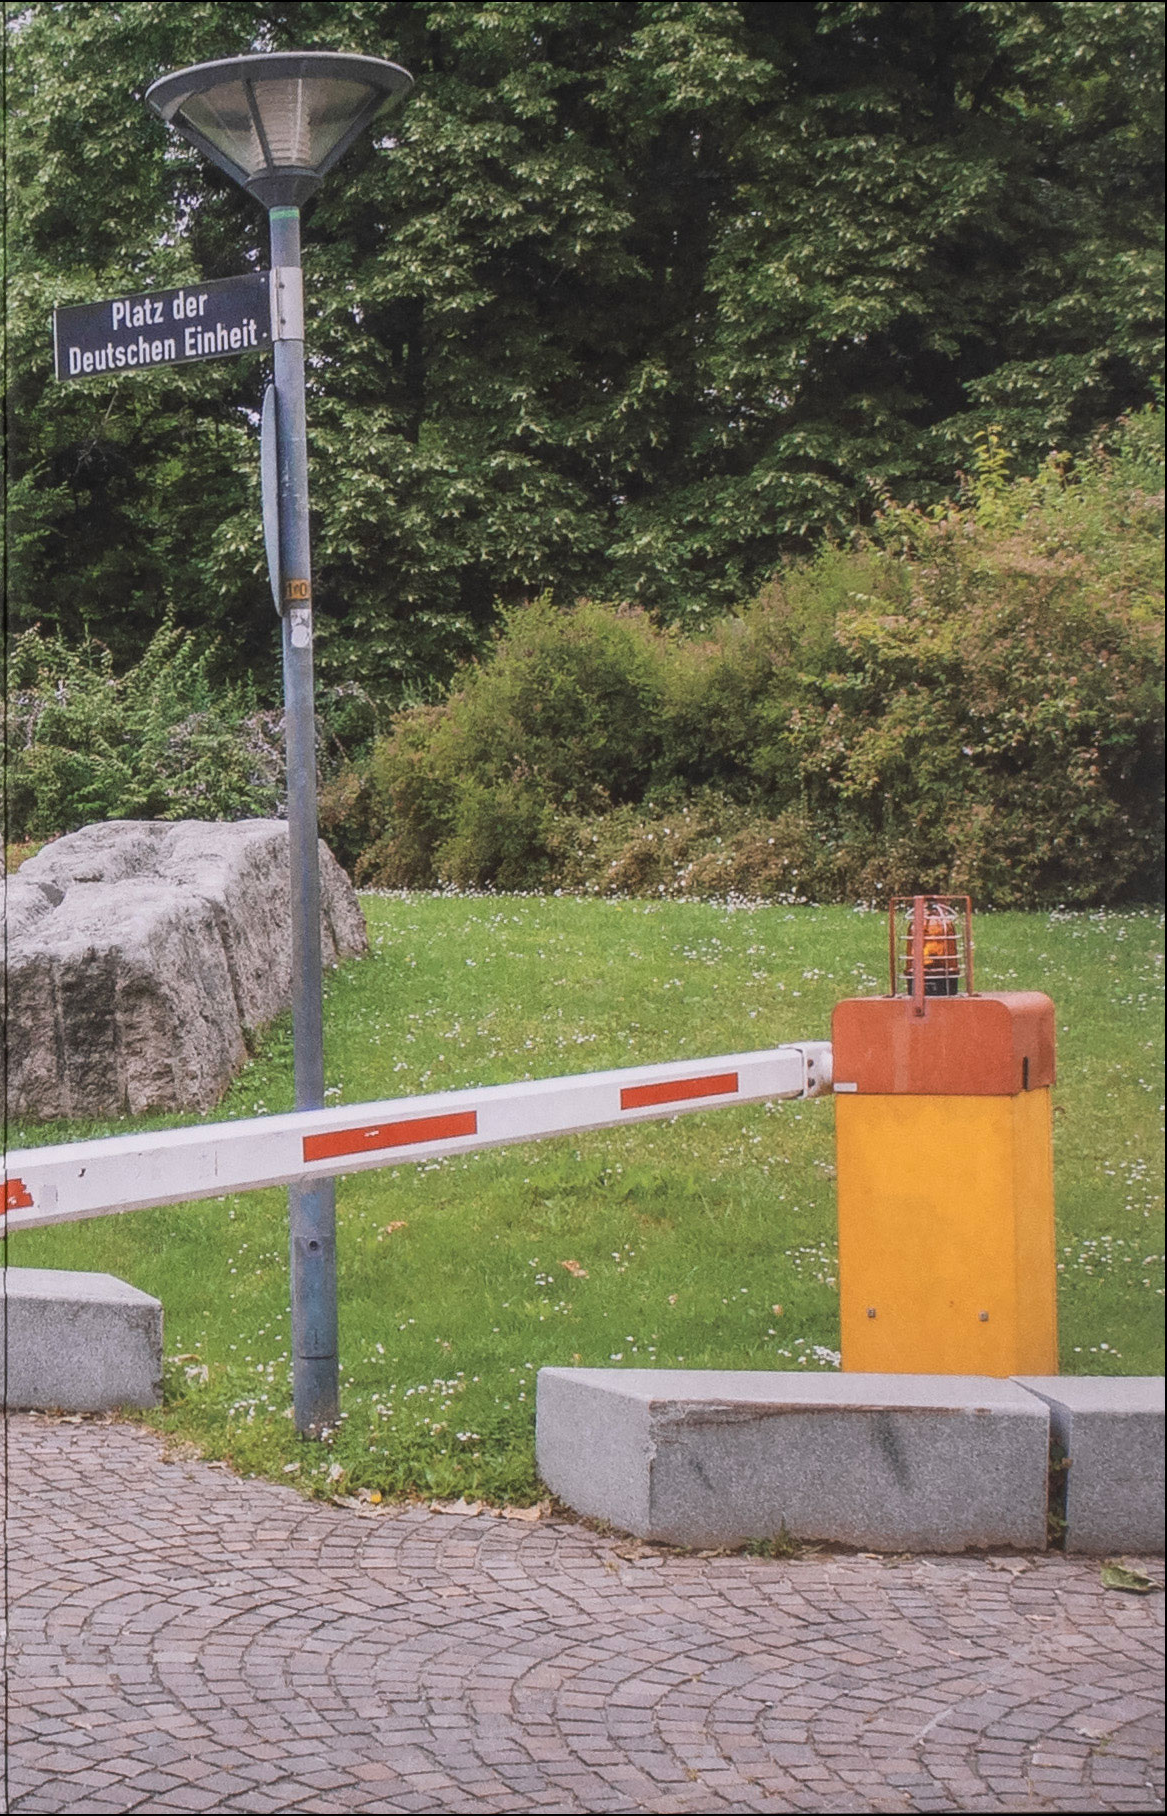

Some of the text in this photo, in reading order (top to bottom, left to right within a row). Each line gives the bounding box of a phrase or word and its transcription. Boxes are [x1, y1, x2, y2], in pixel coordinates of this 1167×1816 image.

[112, 291, 208, 331] Platz der
[69, 318, 258, 375] Deutschen Einheit
